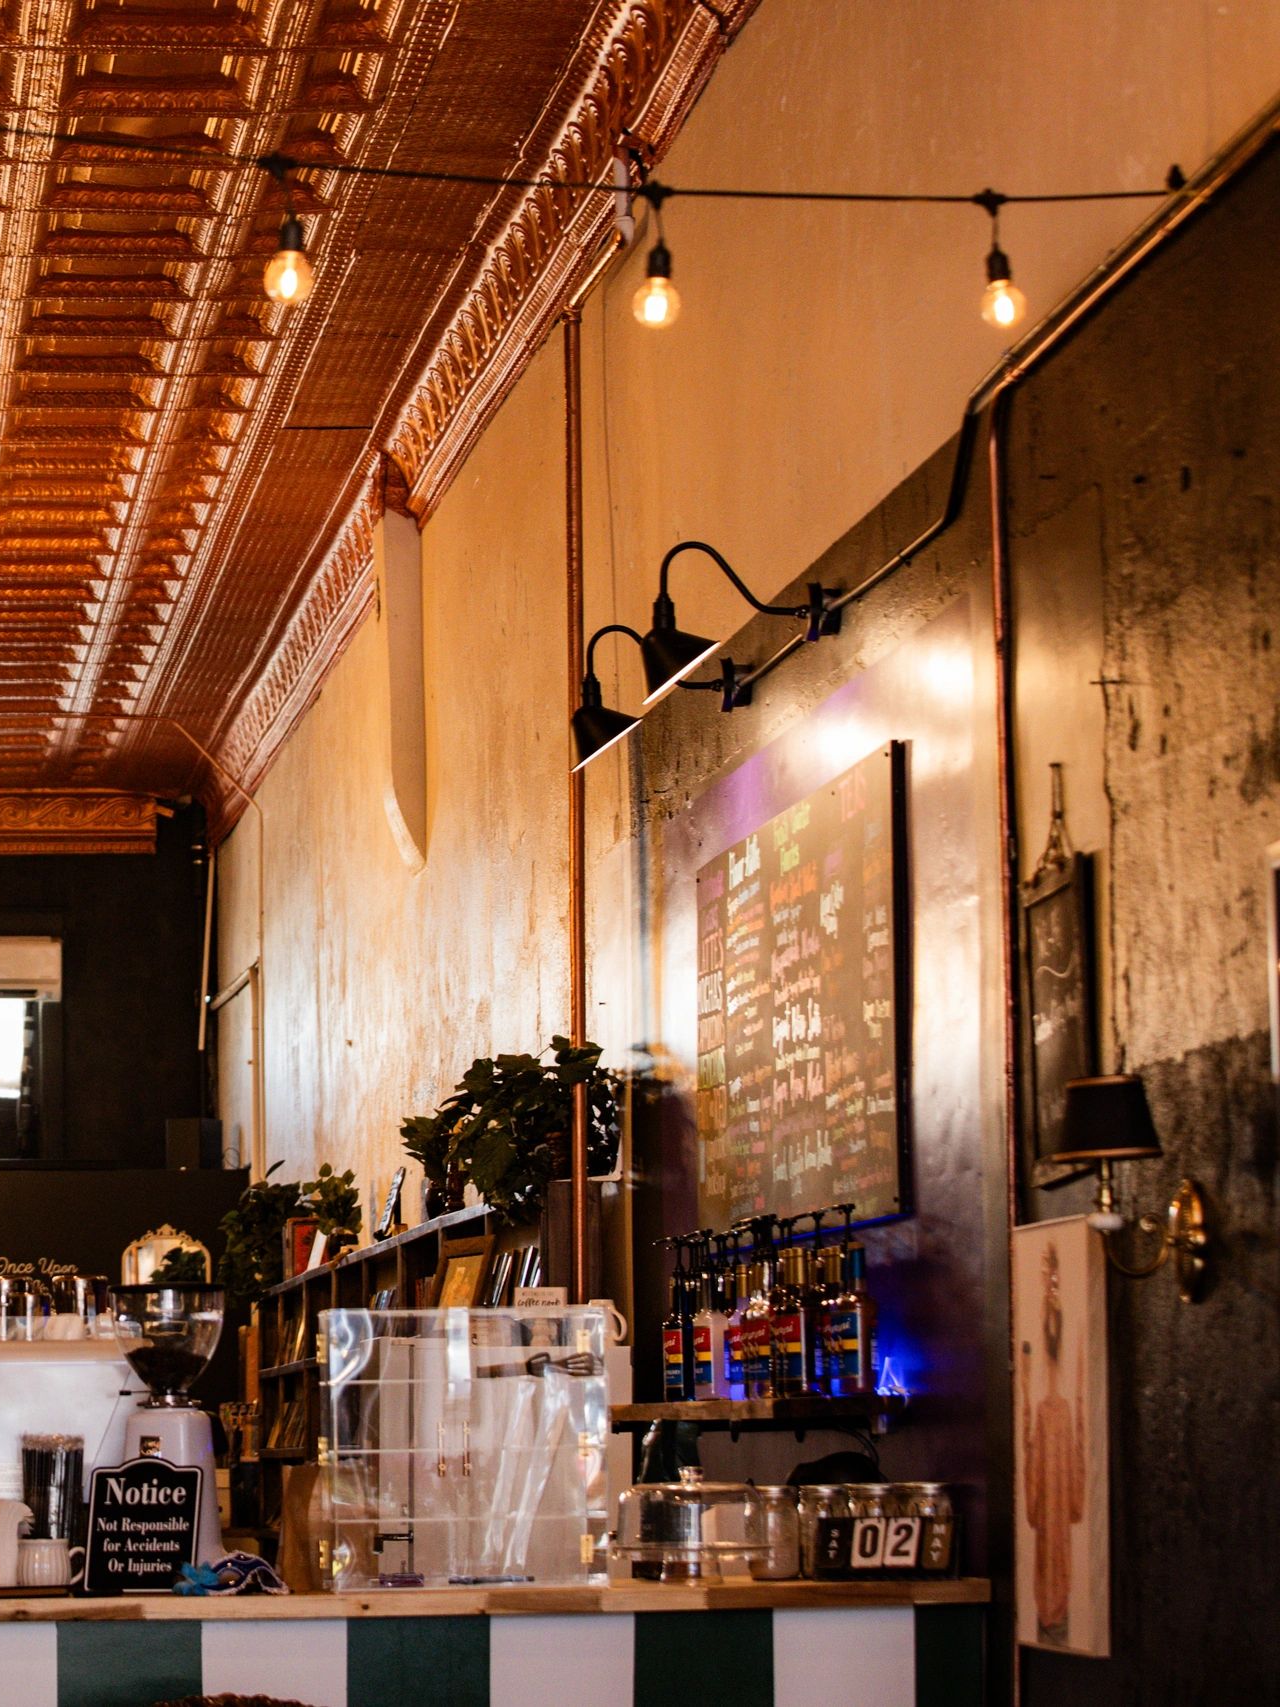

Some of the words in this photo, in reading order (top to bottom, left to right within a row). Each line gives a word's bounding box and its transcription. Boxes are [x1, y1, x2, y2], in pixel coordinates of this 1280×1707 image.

[38, 1257, 79, 1277] Upon
[517, 1297, 540, 1307] coffee
[104, 1477, 187, 1505] Notice
[96, 1517, 118, 1532] Not
[121, 1516, 190, 1536] Responsible
[103, 1537, 121, 1552] for
[124, 1537, 180, 1552] Accidents
[827, 1528, 840, 1559] SAT
[858, 1523, 914, 1558] 02
[930, 1523, 946, 1562] MAY
[107, 1558, 124, 1573] Or
[127, 1558, 172, 1577] Injuries
